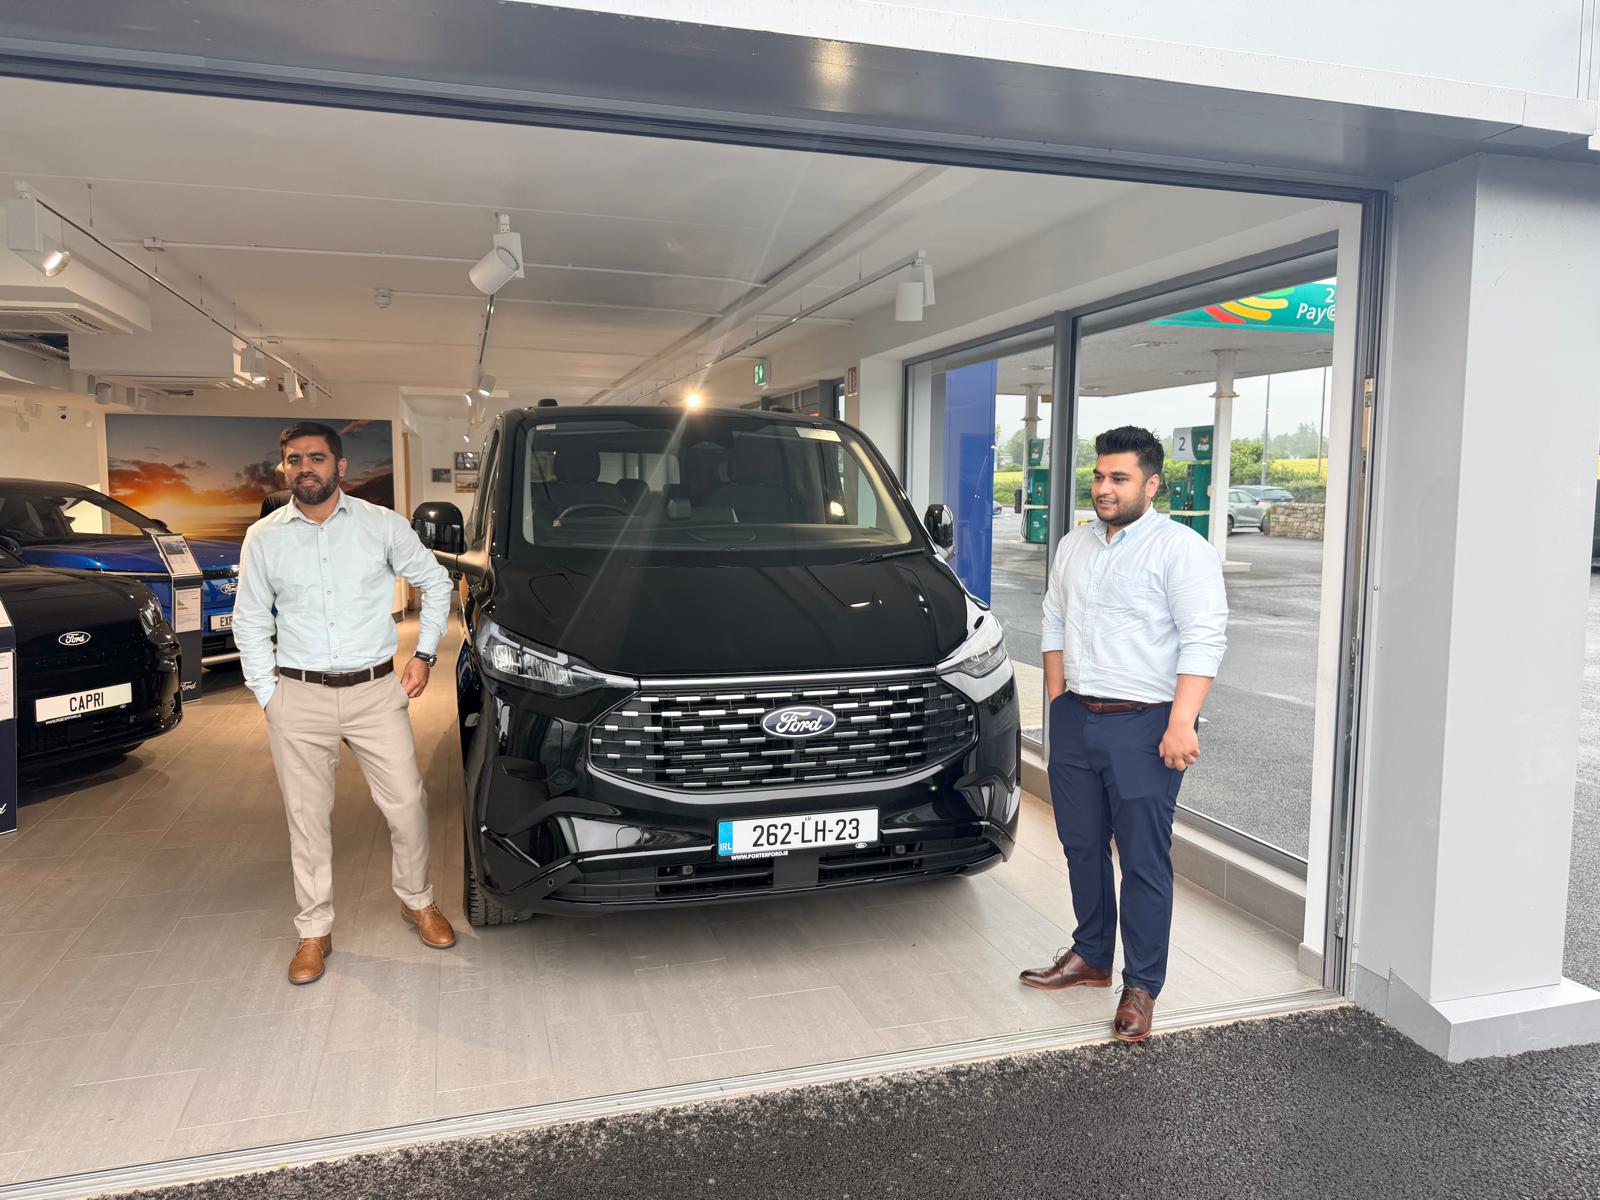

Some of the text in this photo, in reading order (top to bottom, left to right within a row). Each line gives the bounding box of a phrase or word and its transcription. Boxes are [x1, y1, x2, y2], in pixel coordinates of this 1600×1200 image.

[1325, 287, 1335, 303] 2
[1178, 437, 1186, 451] 2
[69, 692, 104, 712] CAPRI
[775, 711, 822, 733] Ford
[752, 818, 860, 848] 262-LH-23
